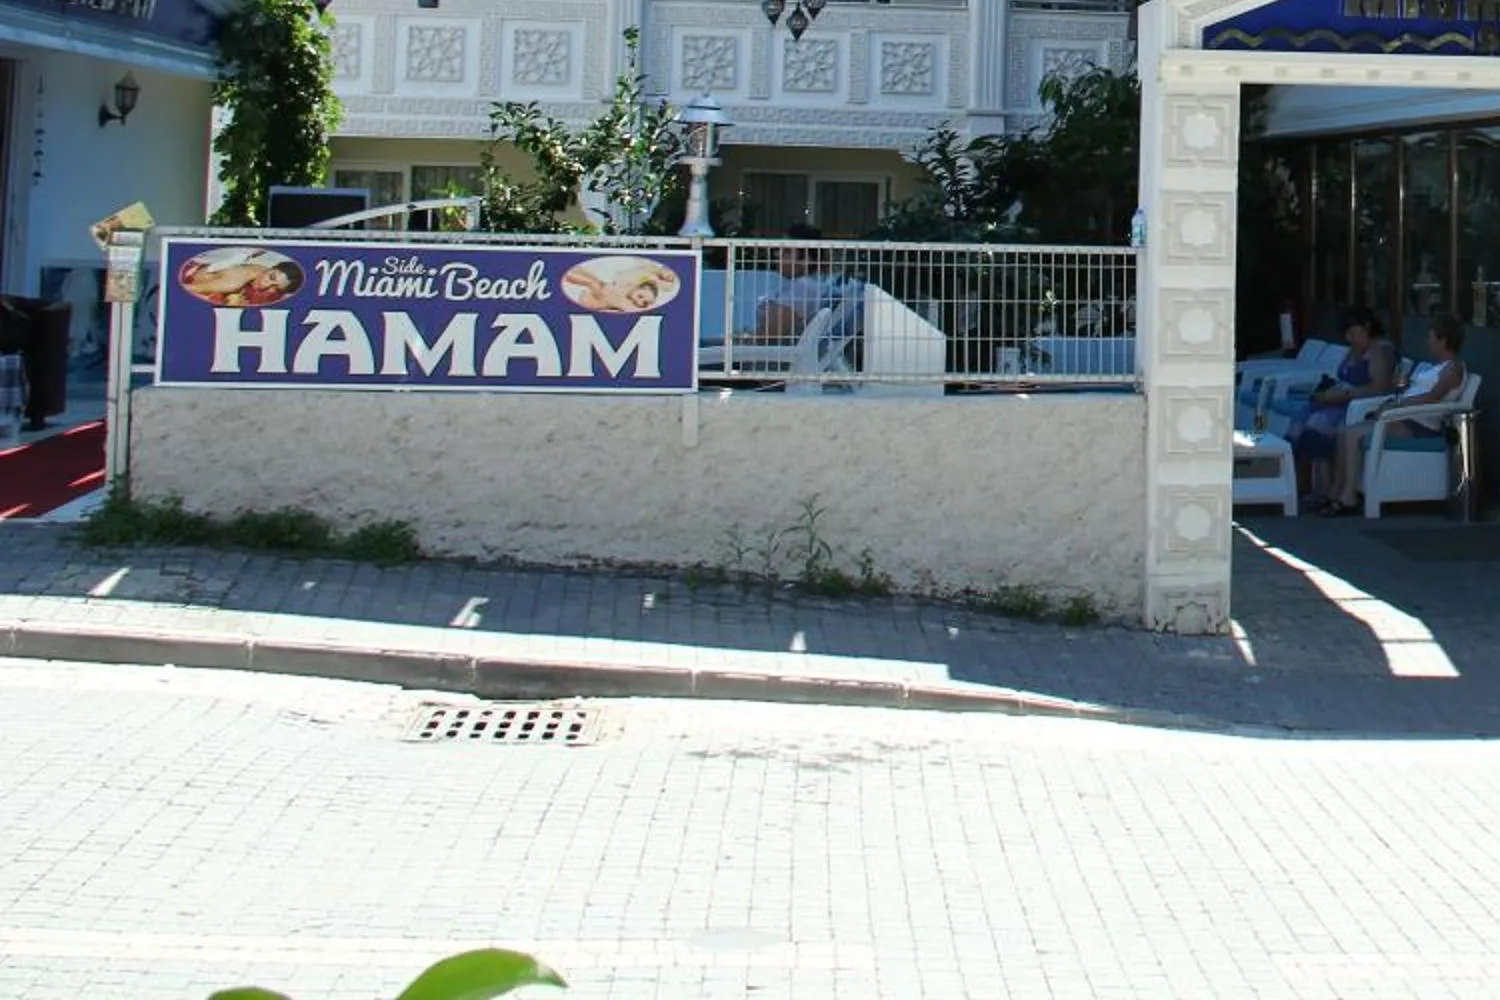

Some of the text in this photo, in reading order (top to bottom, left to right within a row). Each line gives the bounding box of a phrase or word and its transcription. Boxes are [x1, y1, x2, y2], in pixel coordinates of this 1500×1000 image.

[315, 258, 552, 302] Miami Beach
[381, 255, 427, 276] Side
[209, 307, 664, 380] HAMAM
